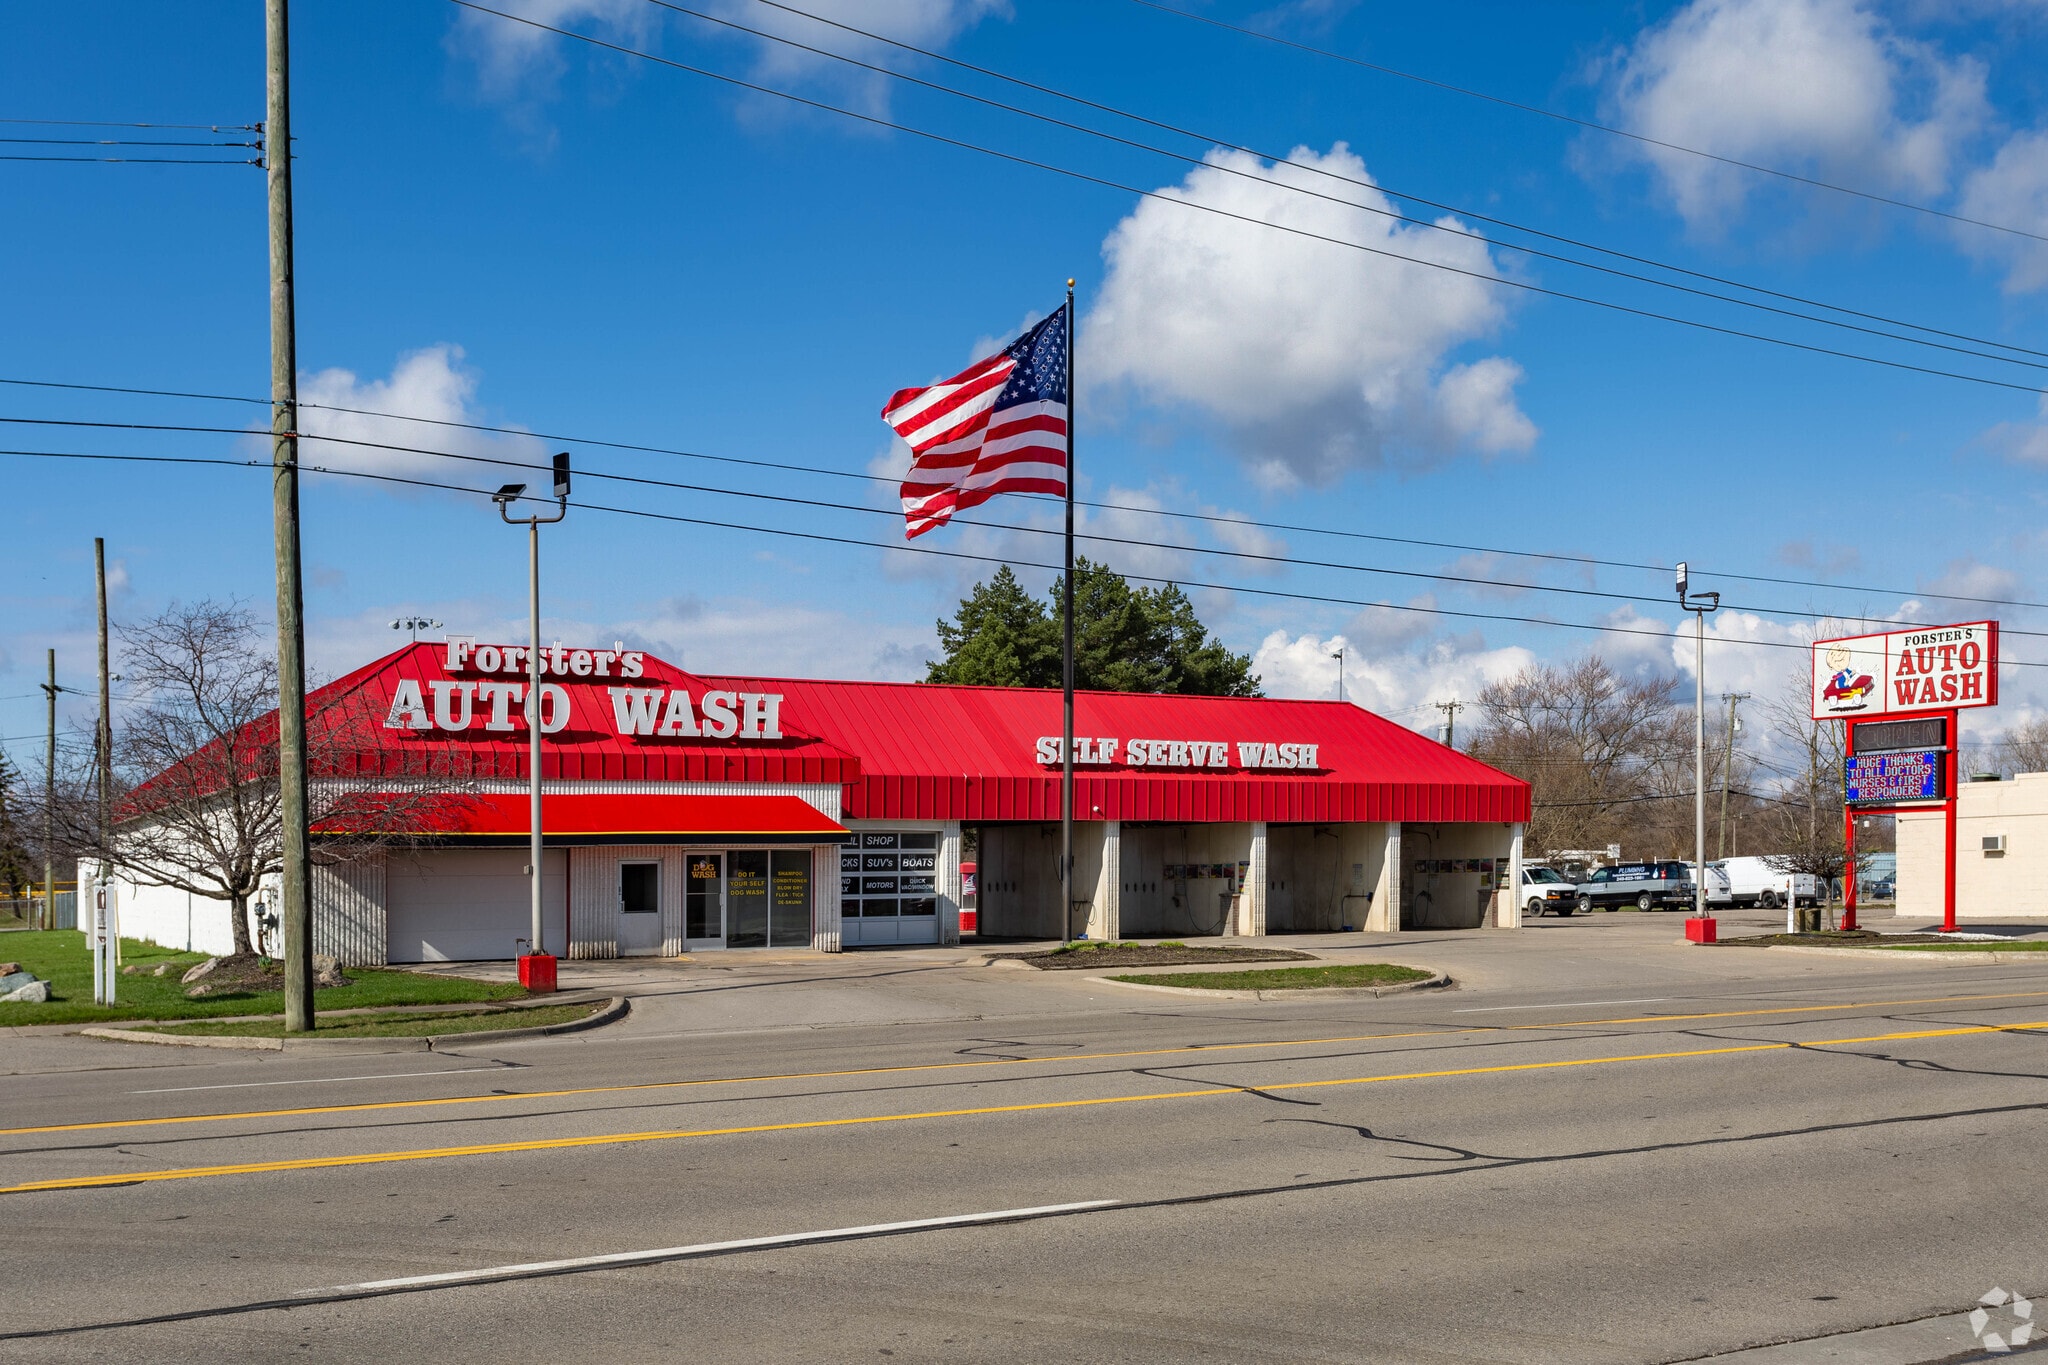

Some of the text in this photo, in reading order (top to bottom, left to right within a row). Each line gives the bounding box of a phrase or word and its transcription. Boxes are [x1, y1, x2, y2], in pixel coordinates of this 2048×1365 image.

[1904, 628, 1973, 647] FORSTER'S
[444, 634, 644, 679] Forster's
[1896, 641, 1981, 677] AUTO
[1894, 671, 1983, 705] WASH
[383, 679, 784, 740] AUTO WASH
[1876, 721, 1941, 747] OPEN
[1036, 736, 1320, 770] SELF SERVE WASH
[1856, 755, 1924, 769] HUGE THANKS
[1850, 764, 1931, 779] TO ALL DOCTORS
[1849, 777, 1887, 789] NURSES
[1858, 785, 1922, 798] RESPONDERS
[866, 836, 894, 846] SHOP
[693, 863, 714, 871] DOG
[866, 858, 893, 868] SUV's
[902, 857, 934, 867] BOATS
[691, 871, 716, 879] WASH
[865, 881, 894, 889] MOTORS
